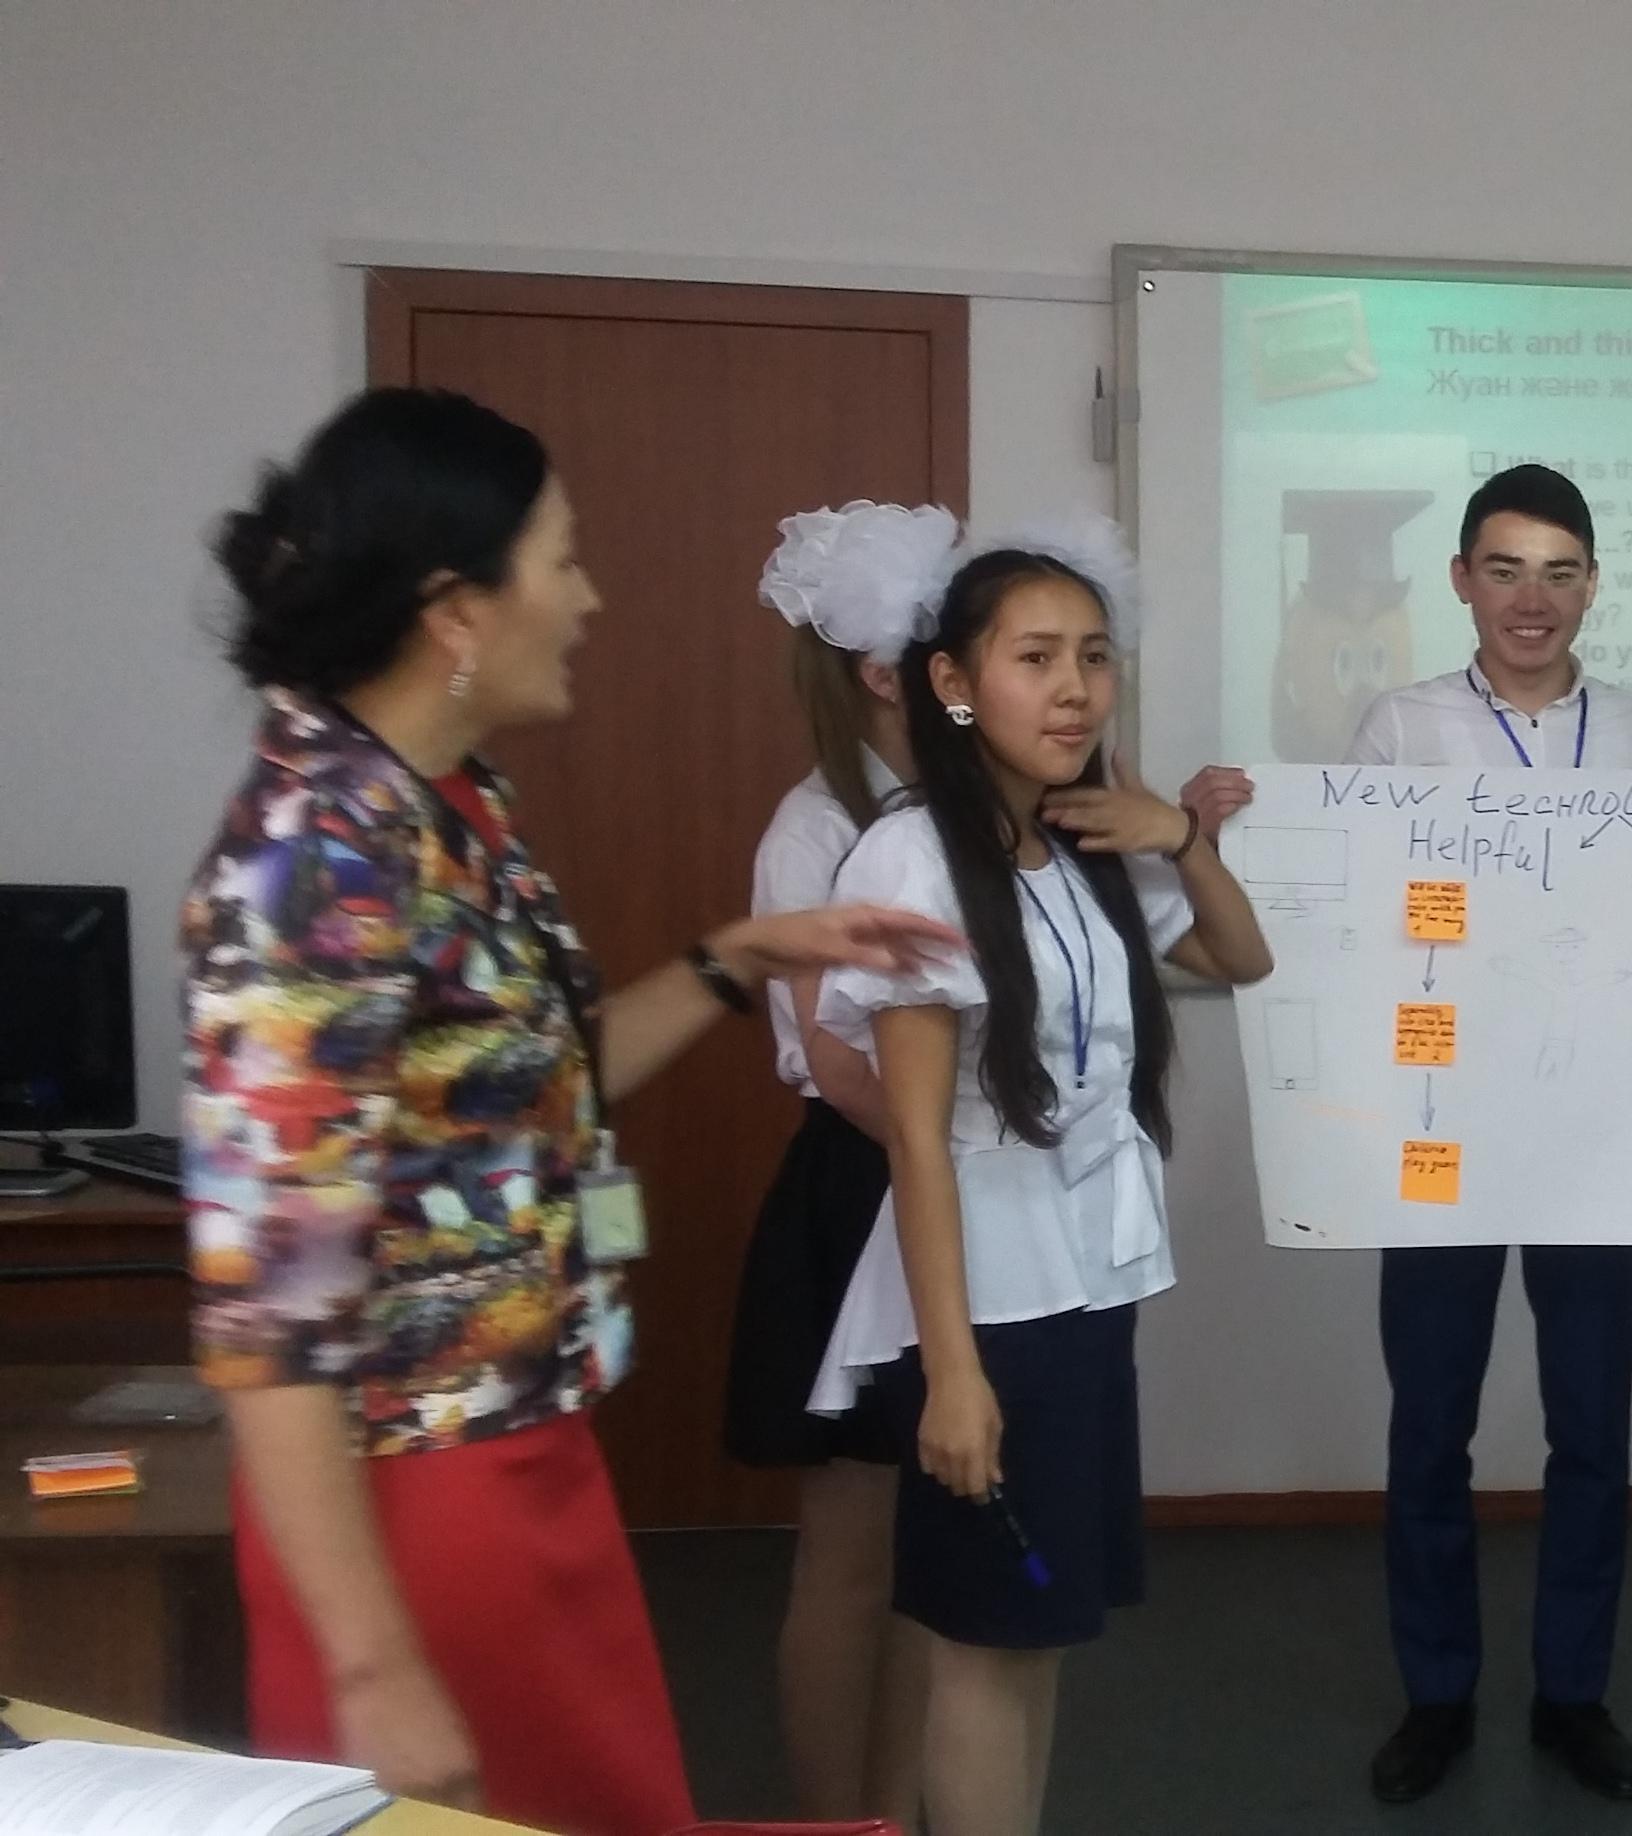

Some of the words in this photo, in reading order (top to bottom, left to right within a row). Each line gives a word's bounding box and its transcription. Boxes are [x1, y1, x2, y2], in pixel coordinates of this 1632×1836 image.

[1426, 326, 1514, 355] Thick
[1524, 328, 1583, 356] and
[1426, 368, 1512, 403] Жуан
[1507, 454, 1576, 479] Wat
[1586, 457, 1607, 480] is
[1322, 768, 1440, 809] New
[1408, 818, 1554, 892] Helpful
